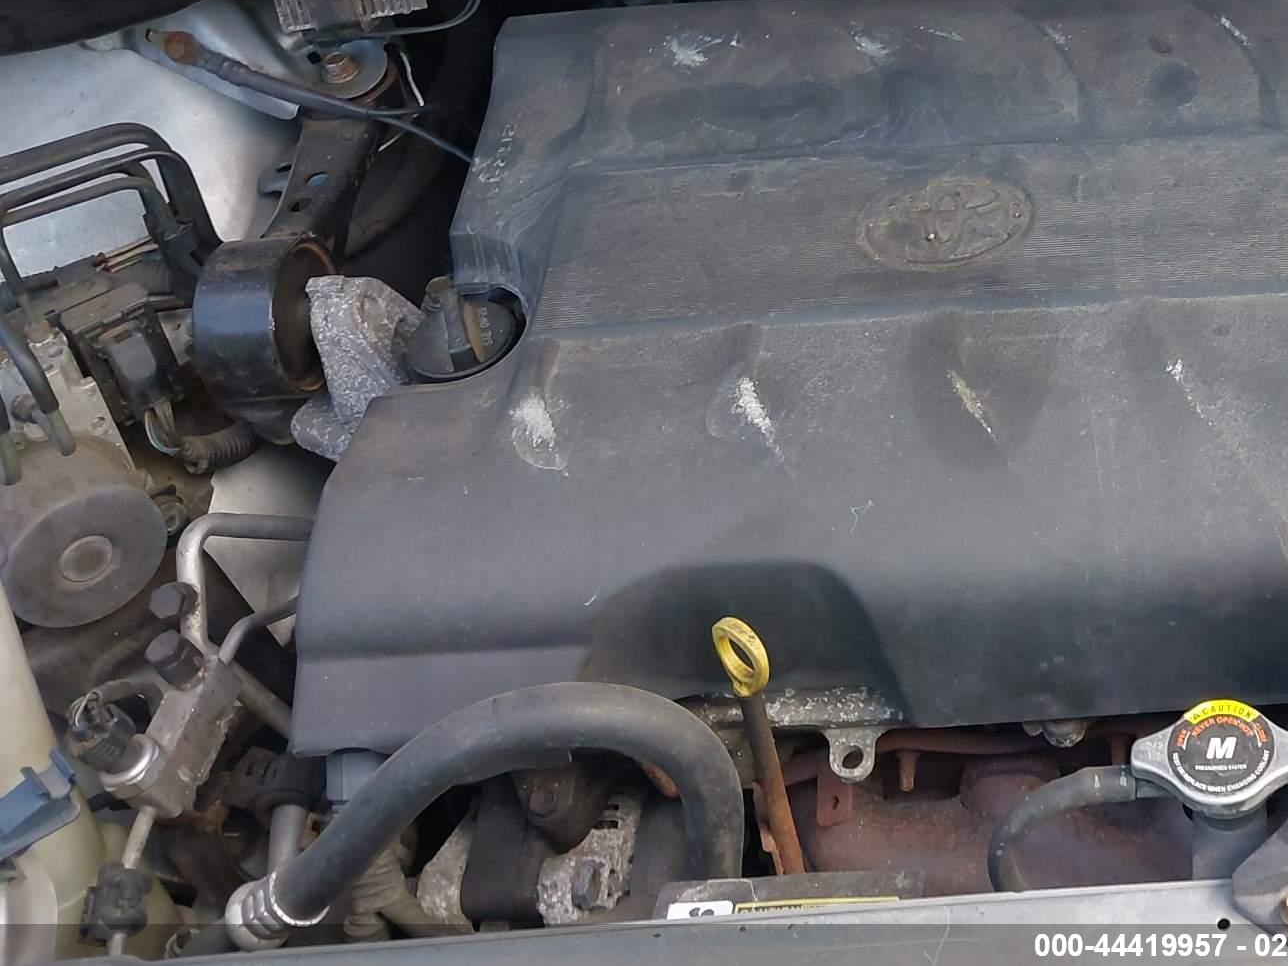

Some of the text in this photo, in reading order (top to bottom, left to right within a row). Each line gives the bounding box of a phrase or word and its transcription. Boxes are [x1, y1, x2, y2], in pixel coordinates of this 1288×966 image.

[1201, 704, 1254, 718] CAUTION
[1191, 716, 1216, 737] NEVER
[1216, 716, 1240, 728] OPEN
[1206, 737, 1237, 759] M
